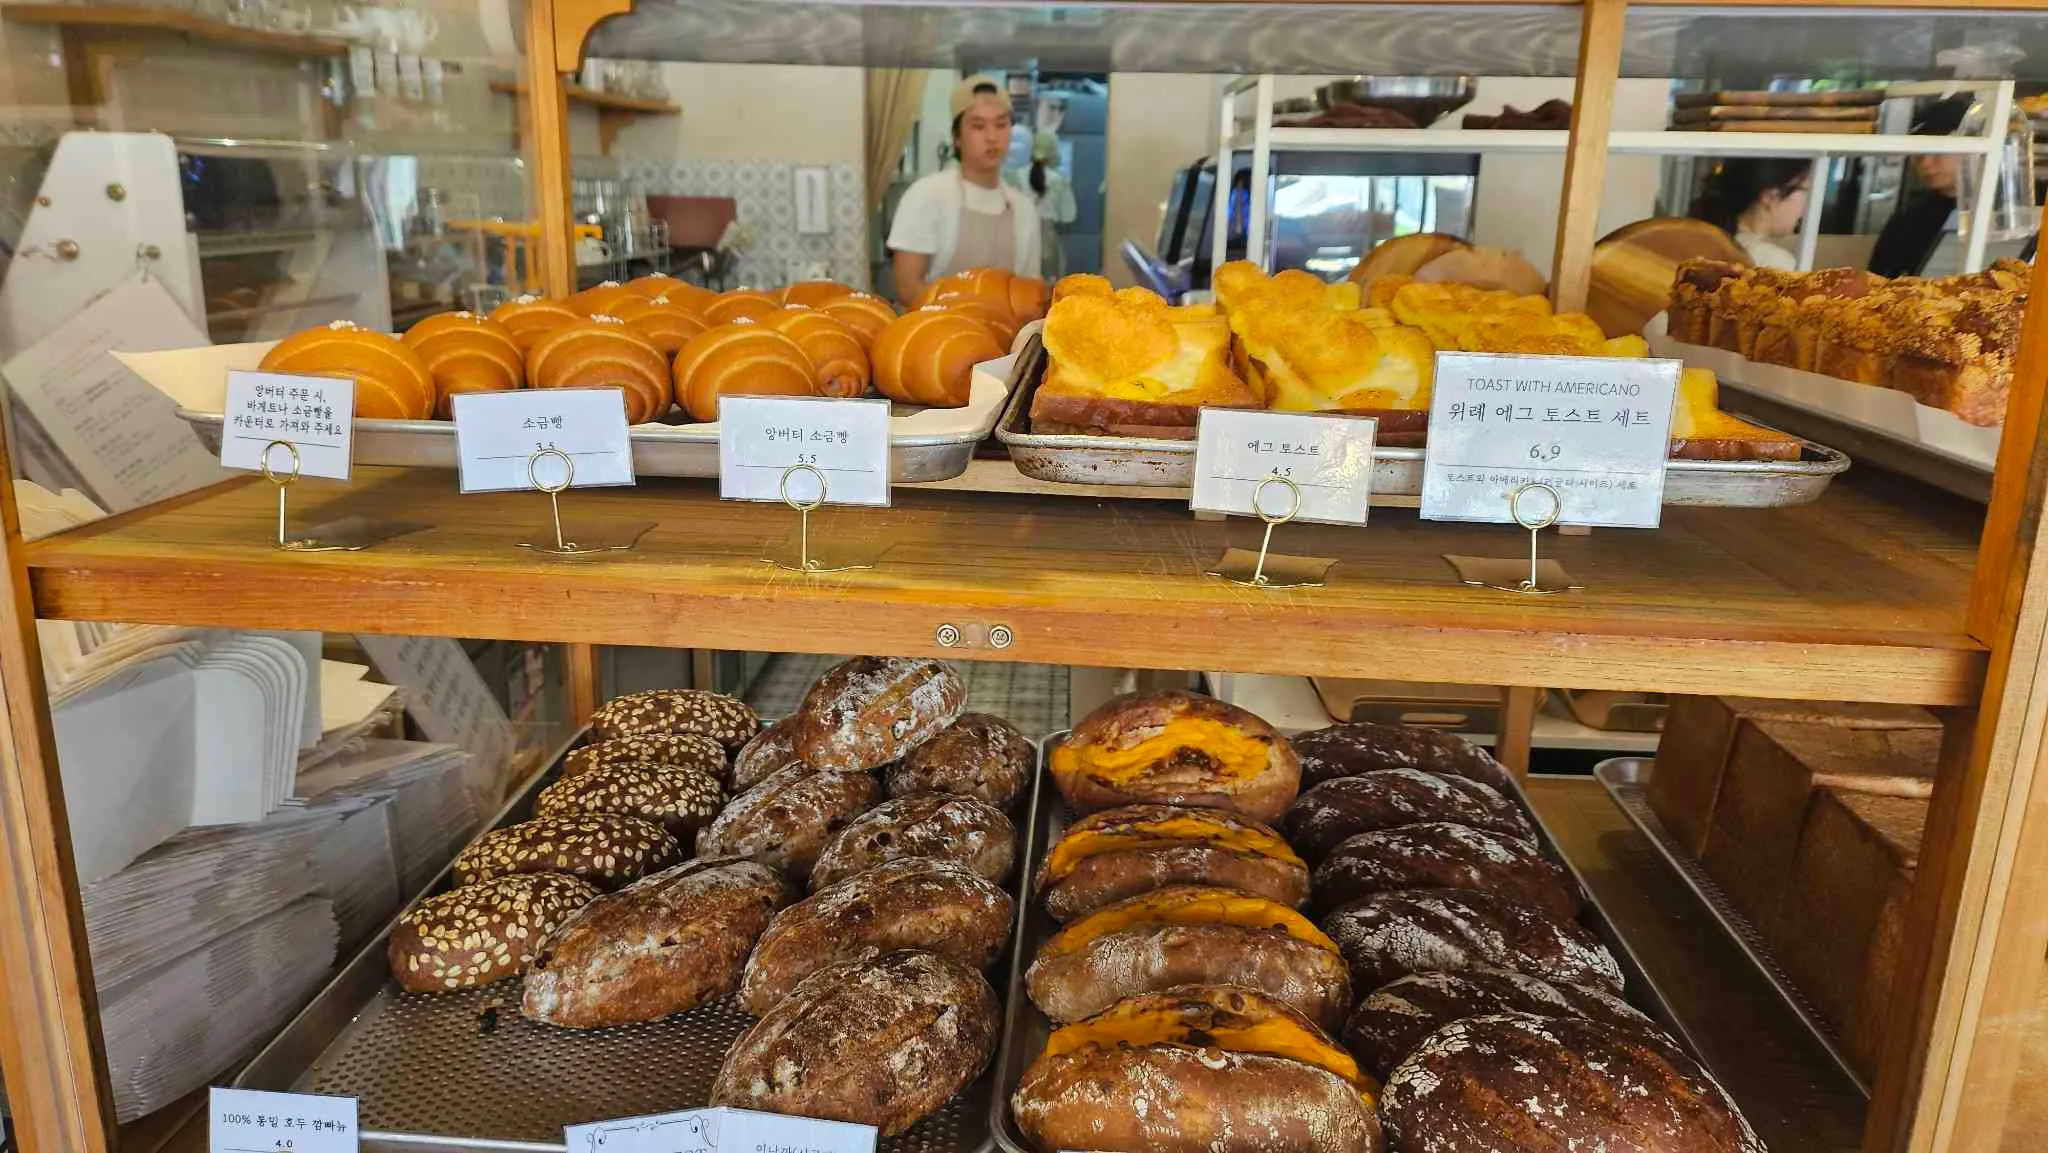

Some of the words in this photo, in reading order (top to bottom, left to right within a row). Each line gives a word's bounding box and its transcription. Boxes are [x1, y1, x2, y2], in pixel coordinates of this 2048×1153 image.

[255, 384, 285, 400] 앙버터
[289, 387, 310, 401] 주문
[1467, 378, 1513, 392] TOAST
[1516, 380, 1551, 393] WITH
[1555, 382, 1641, 397] AMERICANO
[247, 399, 288, 415] 바게트나
[292, 405, 333, 420] 소금빵을
[1449, 402, 1487, 422] 위례
[1495, 404, 1534, 423] 에그
[1542, 408, 1603, 424] 토스트
[1608, 409, 1652, 429] 세트
[233, 415, 275, 429] 카운터로
[279, 418, 310, 433] 가져와
[314, 421, 342, 436] 주세요
[522, 415, 562, 430] 소금빵
[765, 427, 803, 442] 앙버터
[809, 430, 849, 444] 소금빵
[1247, 440, 1273, 453] 에그
[1279, 443, 1320, 456] 토스트
[1529, 443, 1561, 462] 6.9
[798, 454, 817, 464] 5.5
[1271, 467, 1292, 477] 4.5
[223, 1113, 252, 1125] 100%
[284, 1117, 309, 1130] 호두
[312, 1119, 347, 1133] 깜빠뉴
[275, 1139, 293, 1148] 4.0
